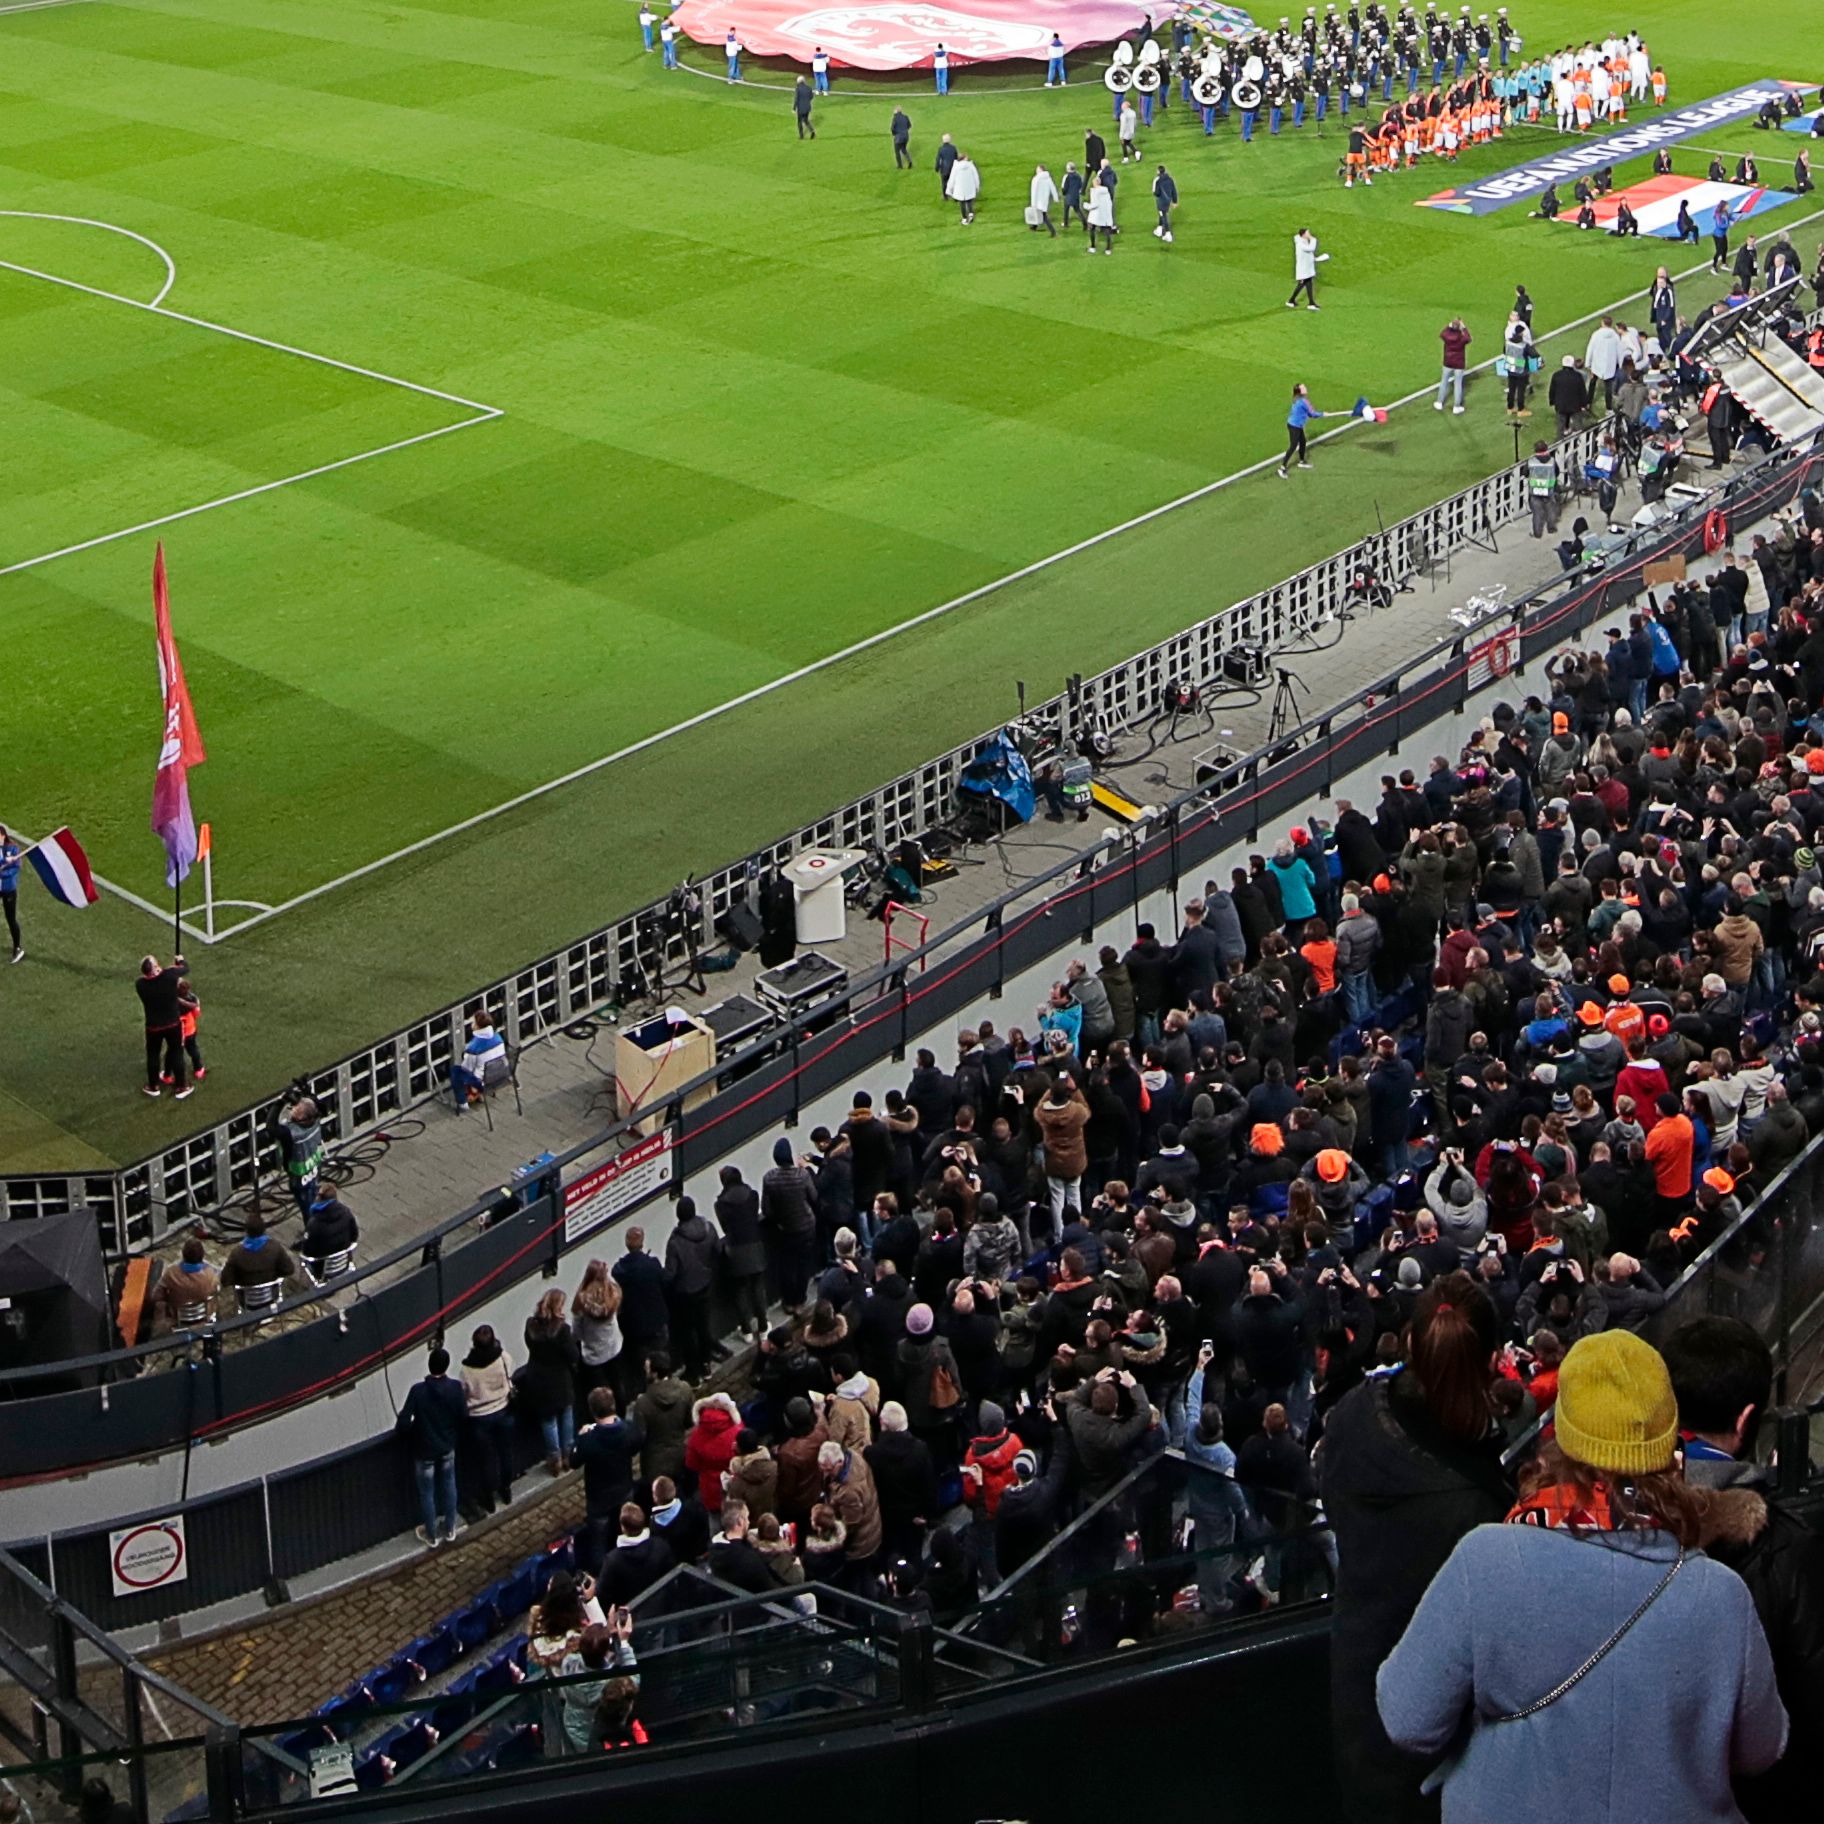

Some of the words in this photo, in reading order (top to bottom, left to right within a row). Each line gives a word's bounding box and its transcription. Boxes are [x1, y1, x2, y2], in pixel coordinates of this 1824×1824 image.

[1465, 166, 1547, 200] UEFA
[1542, 124, 1679, 181] NATIONS
[1669, 88, 1786, 133] LEAGUE
